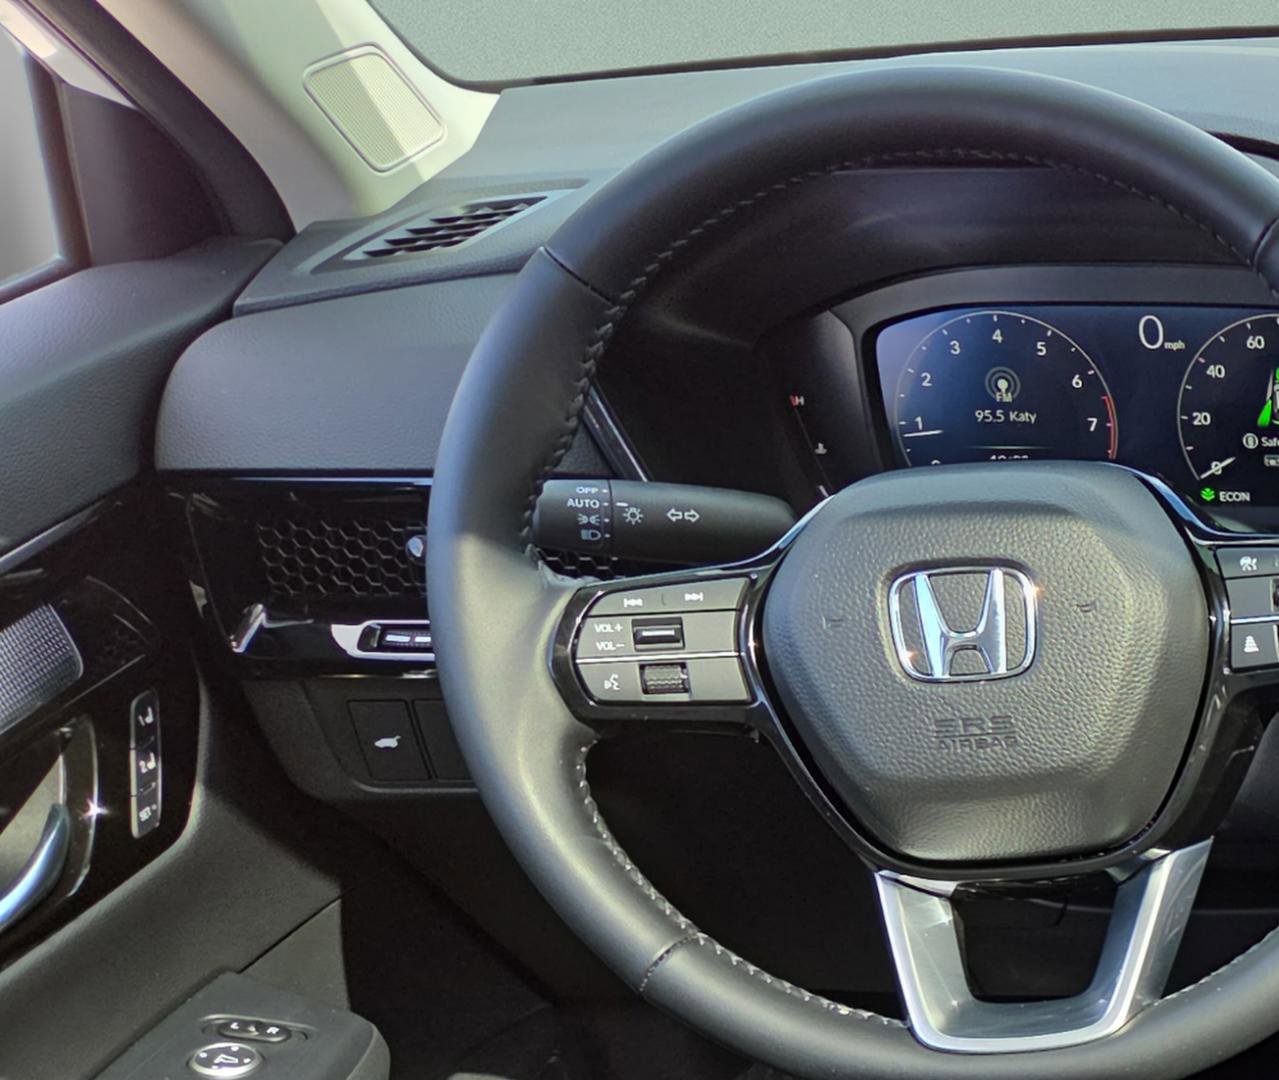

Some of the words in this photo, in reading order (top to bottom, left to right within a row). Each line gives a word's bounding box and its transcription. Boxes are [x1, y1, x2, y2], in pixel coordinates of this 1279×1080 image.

[992, 329, 1003, 343] 4
[1138, 315, 1164, 349] 0
[1164, 340, 1185, 351] mph
[950, 341, 961, 355] 3
[1036, 342, 1047, 356] 5
[1246, 336, 1265, 349] 60
[1206, 365, 1226, 378] 40
[921, 373, 932, 387] 2
[1072, 374, 1083, 388] 6
[996, 392, 1012, 402] FM
[914, 416, 923, 430] 1
[975, 410, 1005, 422] 95.5
[1009, 410, 1037, 424] Katy
[1192, 412, 1211, 426] 20
[1087, 418, 1098, 431] 7
[567, 499, 600, 508] AUTO
[1219, 492, 1250, 501] ECON
